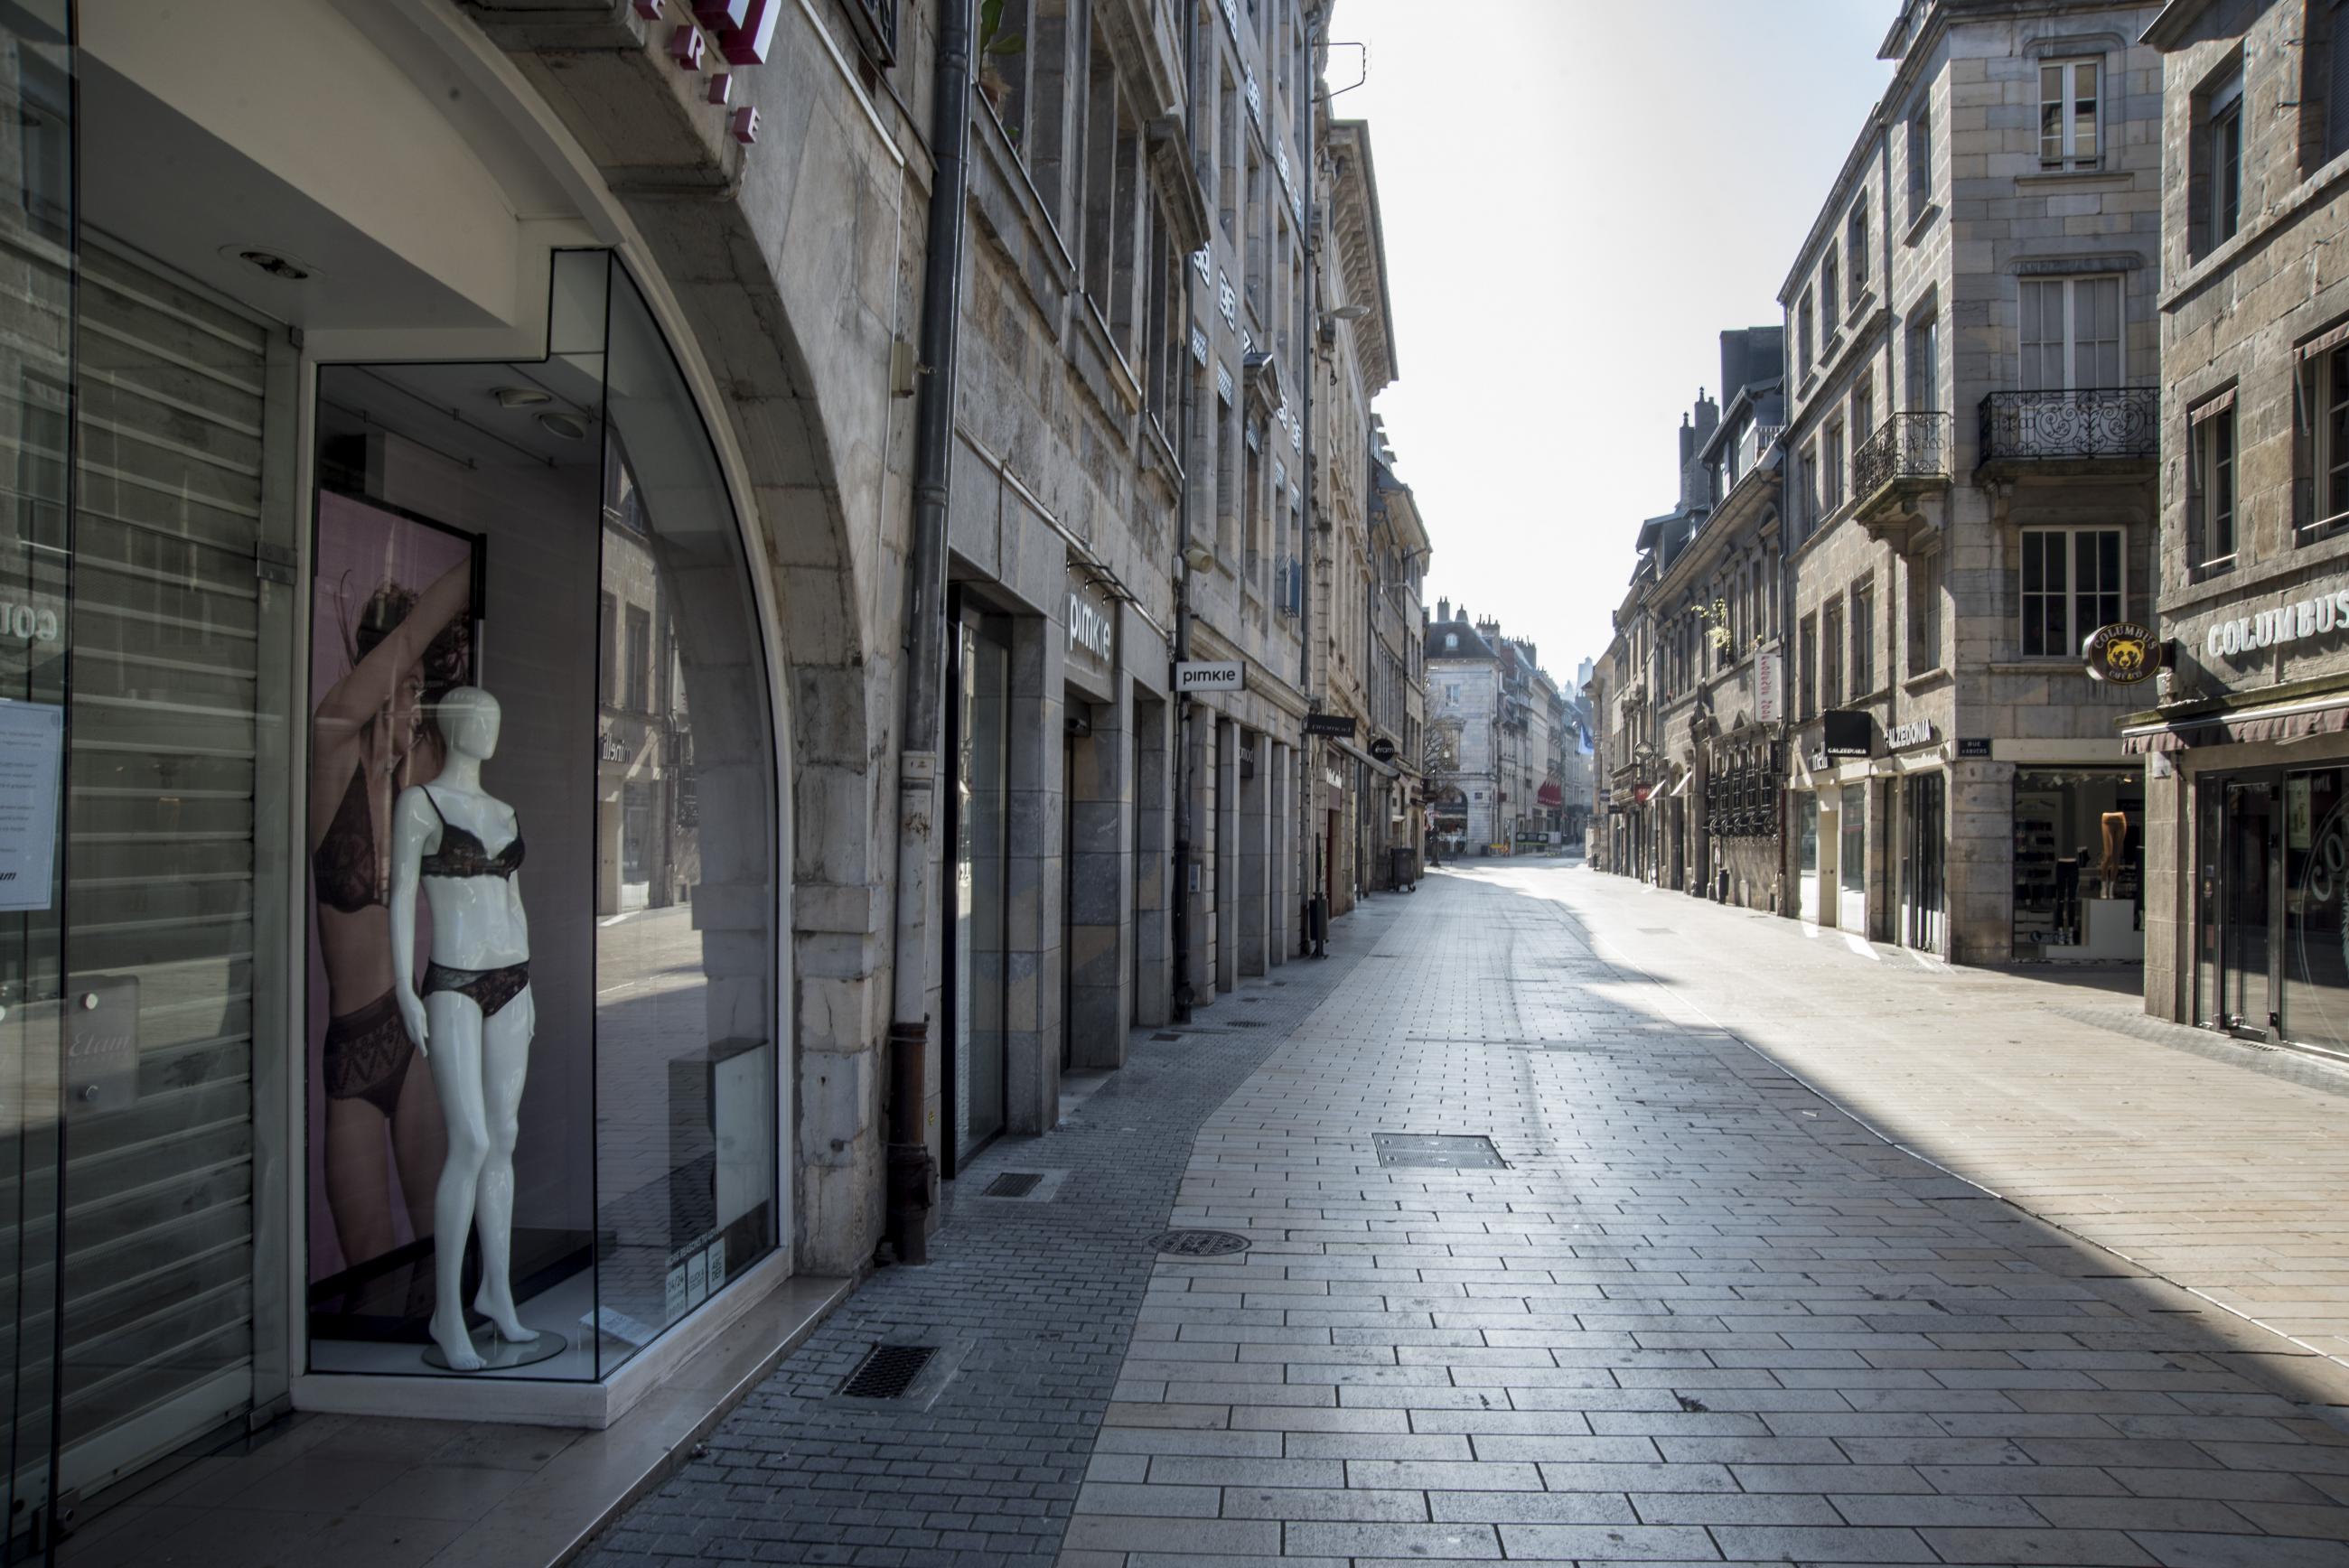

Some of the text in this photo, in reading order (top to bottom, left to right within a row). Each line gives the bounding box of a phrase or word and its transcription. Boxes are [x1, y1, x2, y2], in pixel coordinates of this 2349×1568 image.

[1070, 592, 1111, 661] pimkie
[2093, 624, 2157, 649] COLUMBUS
[2207, 588, 2349, 658] COLUMBUS
[1183, 669, 1236, 686] pimkie
[69, 1028, 131, 1057] Etam
